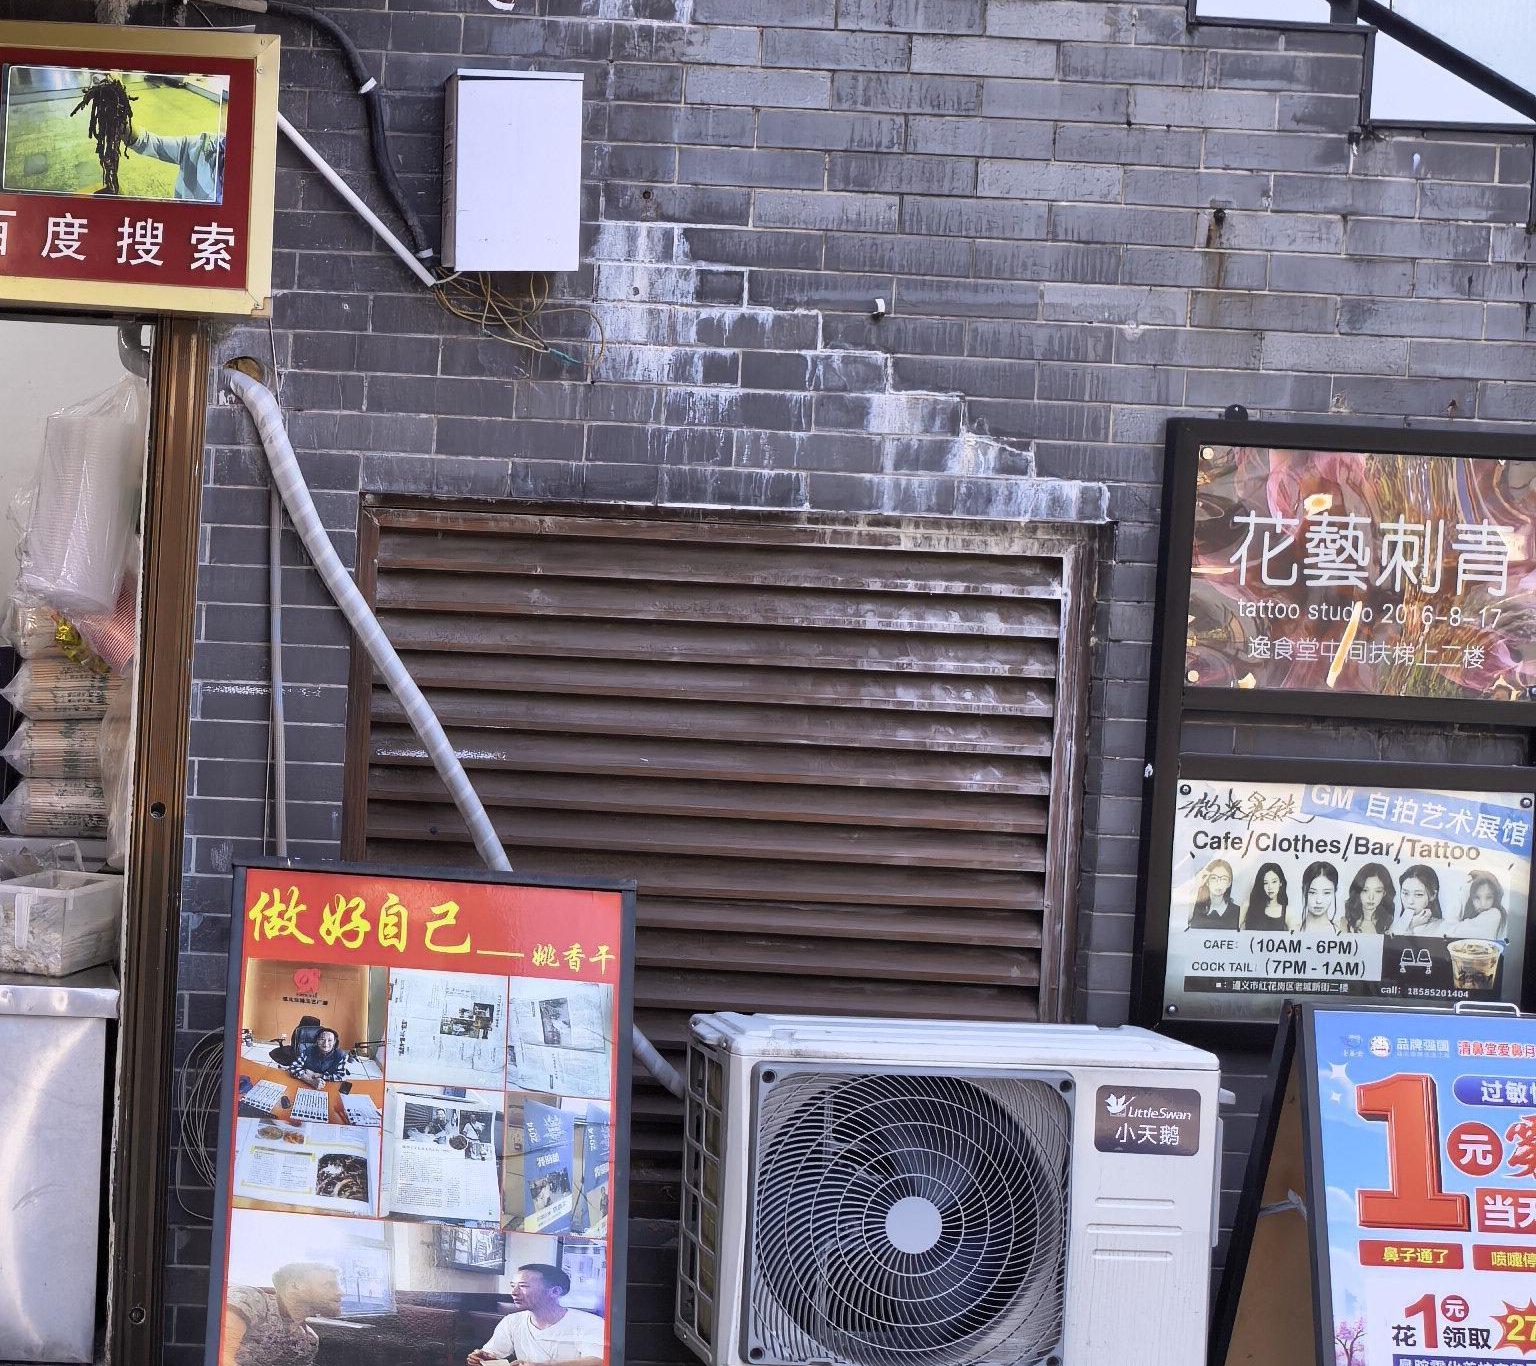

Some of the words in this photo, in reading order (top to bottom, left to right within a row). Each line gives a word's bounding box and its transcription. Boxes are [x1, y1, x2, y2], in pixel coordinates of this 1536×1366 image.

[1230, 510, 1515, 597] 花藝刺青
[1238, 598, 1300, 619] tattoo
[1308, 601, 1373, 623] studo
[1382, 603, 1502, 629] 2016-8-17
[1311, 784, 1355, 811] GM
[1366, 791, 1530, 848] 自拍艺术展馆
[1192, 829, 1481, 862] Cafe/Clothes/Bar/Tattoo
[248, 885, 471, 953] 做好自己
[1191, 960, 1226, 973] COCK
[1407, 986, 1470, 999] 18585201404
[1480, 1080, 1536, 1104] 过敏
[1128, 1106, 1192, 1120] LittleSwan
[1115, 1122, 1180, 1146] 小天鹅
[1382, 1246, 1449, 1265] 鼻子通了
